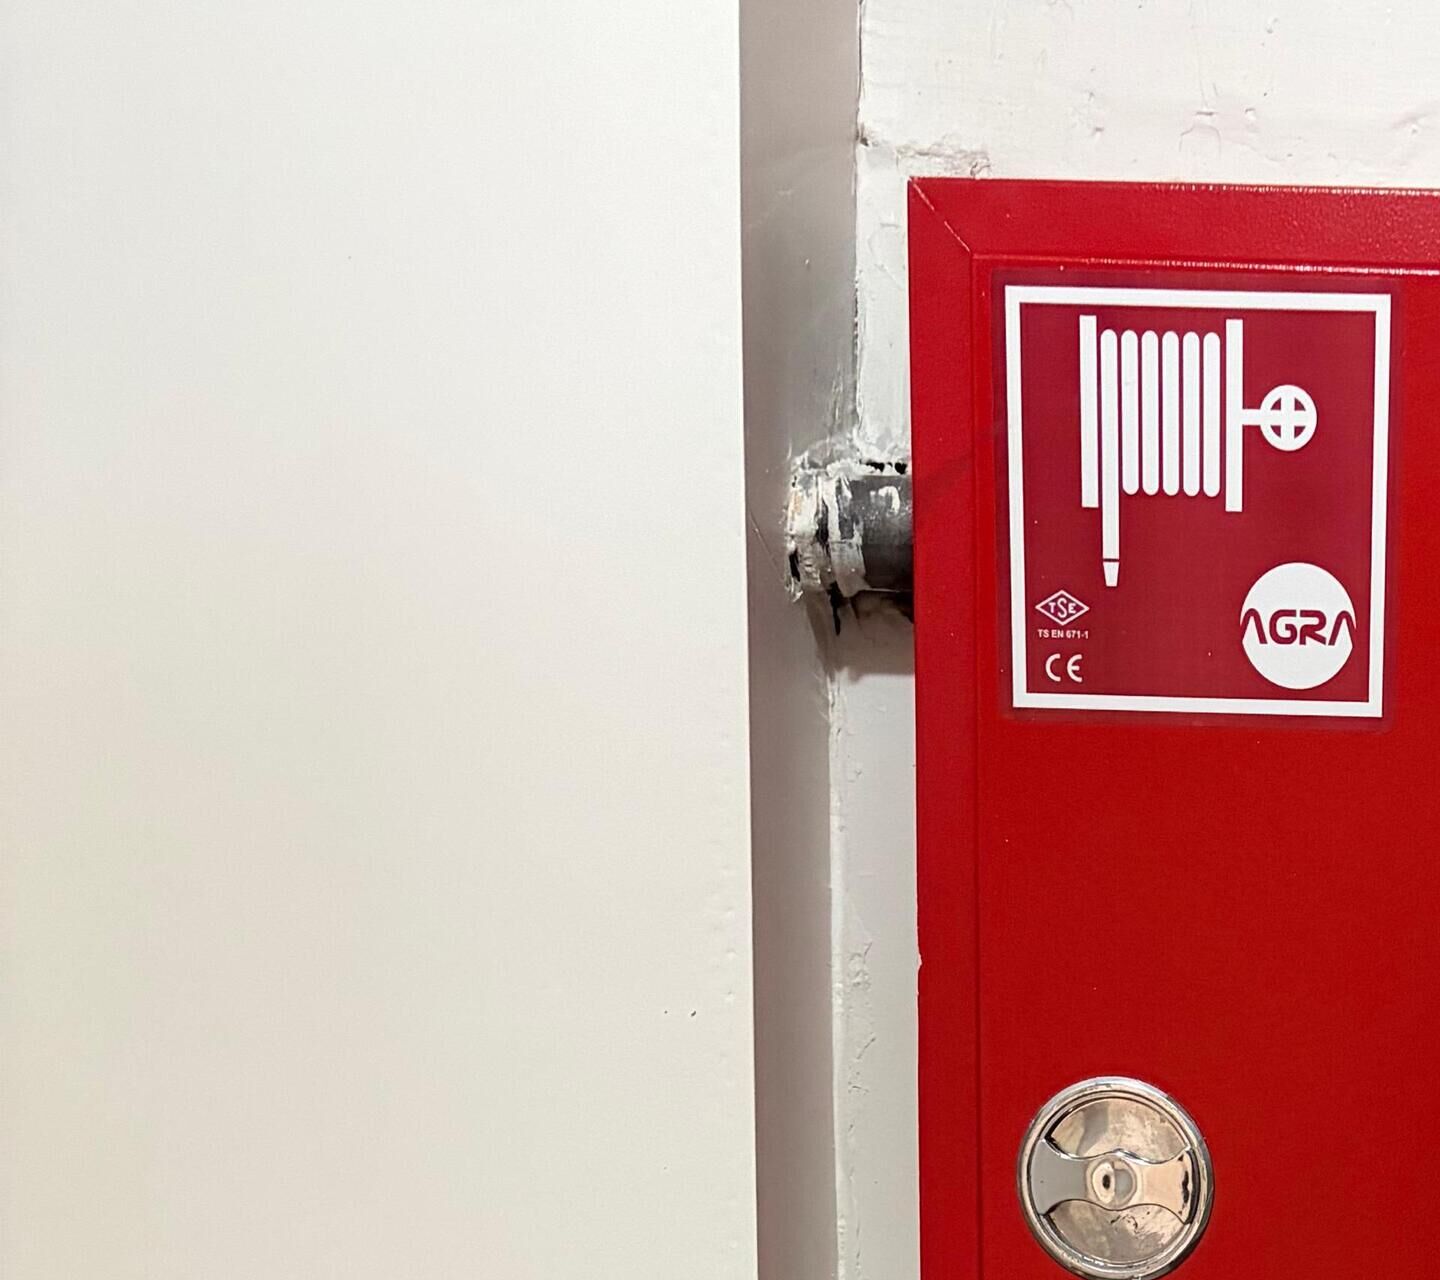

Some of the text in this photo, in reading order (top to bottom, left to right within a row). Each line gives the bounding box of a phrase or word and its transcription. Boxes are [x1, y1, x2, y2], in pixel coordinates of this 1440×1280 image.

[1048, 598, 1076, 618] TSE
[1038, 629, 1089, 639] TS EN 671-1
[1046, 653, 1082, 683] CE
